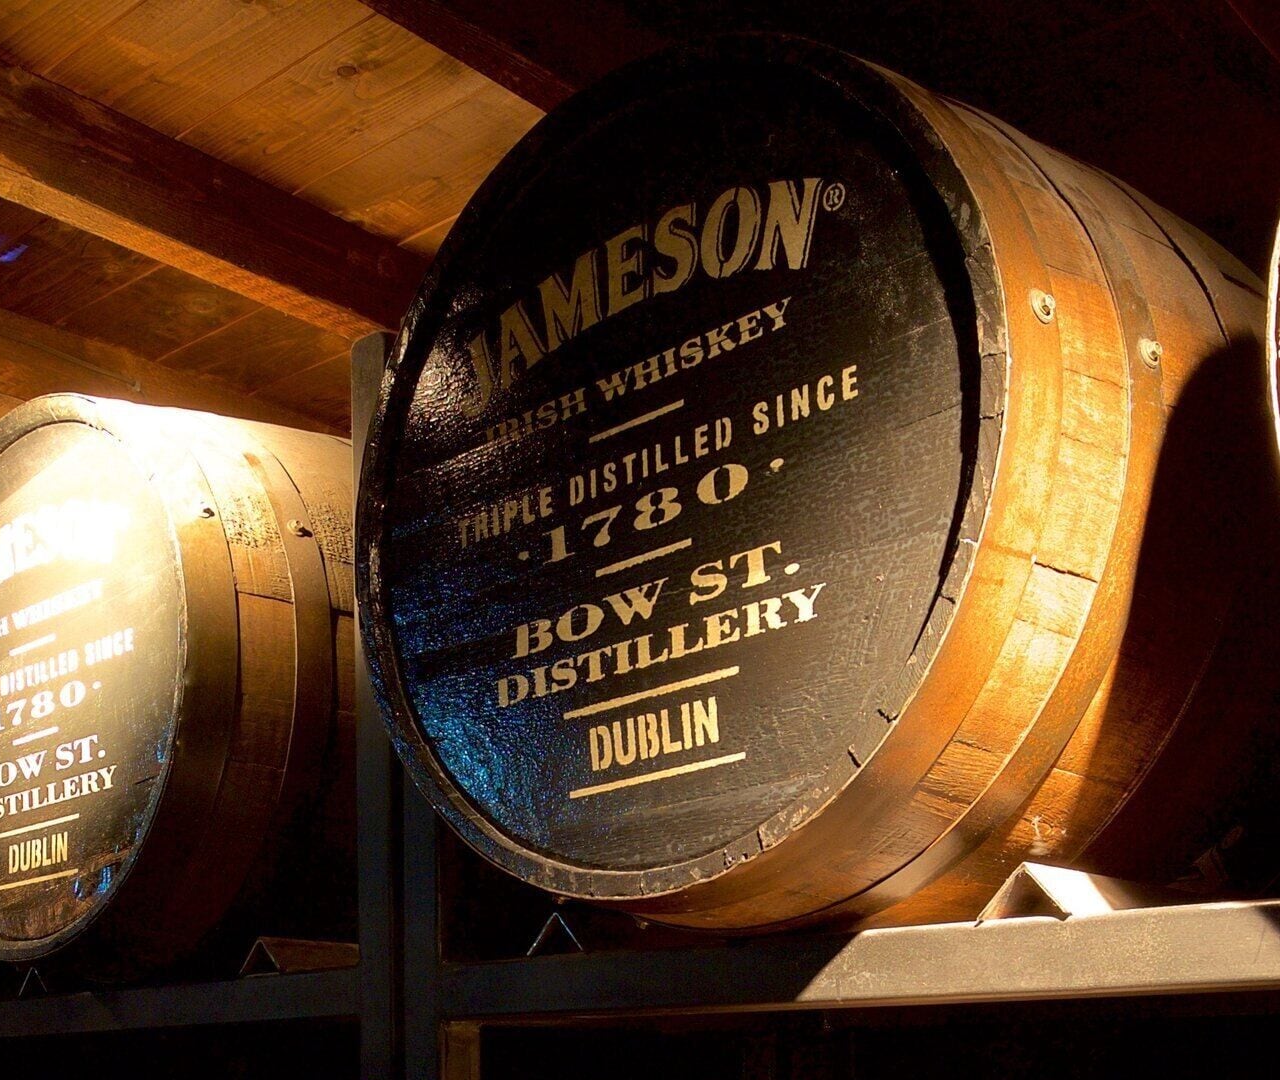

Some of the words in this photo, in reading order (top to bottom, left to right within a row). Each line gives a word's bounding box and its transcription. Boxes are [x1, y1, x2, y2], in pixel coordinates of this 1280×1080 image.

[483, 387, 588, 442] IRISH
[595, 296, 792, 402] WHISKEY
[457, 487, 553, 548] TRIPLE
[569, 416, 732, 507] DISTILLED
[752, 365, 859, 435] SINCE
[496, 582, 827, 709] DISTILLERY
[512, 577, 669, 660] BOW
[689, 541, 801, 607] ST.
[0, 649, 78, 697] DISTILLED
[84, 627, 135, 668] SINCE
[55, 734, 107, 772] ST.
[589, 696, 720, 772] DUBLIN
[9, 832, 68, 875] DUBLIN
